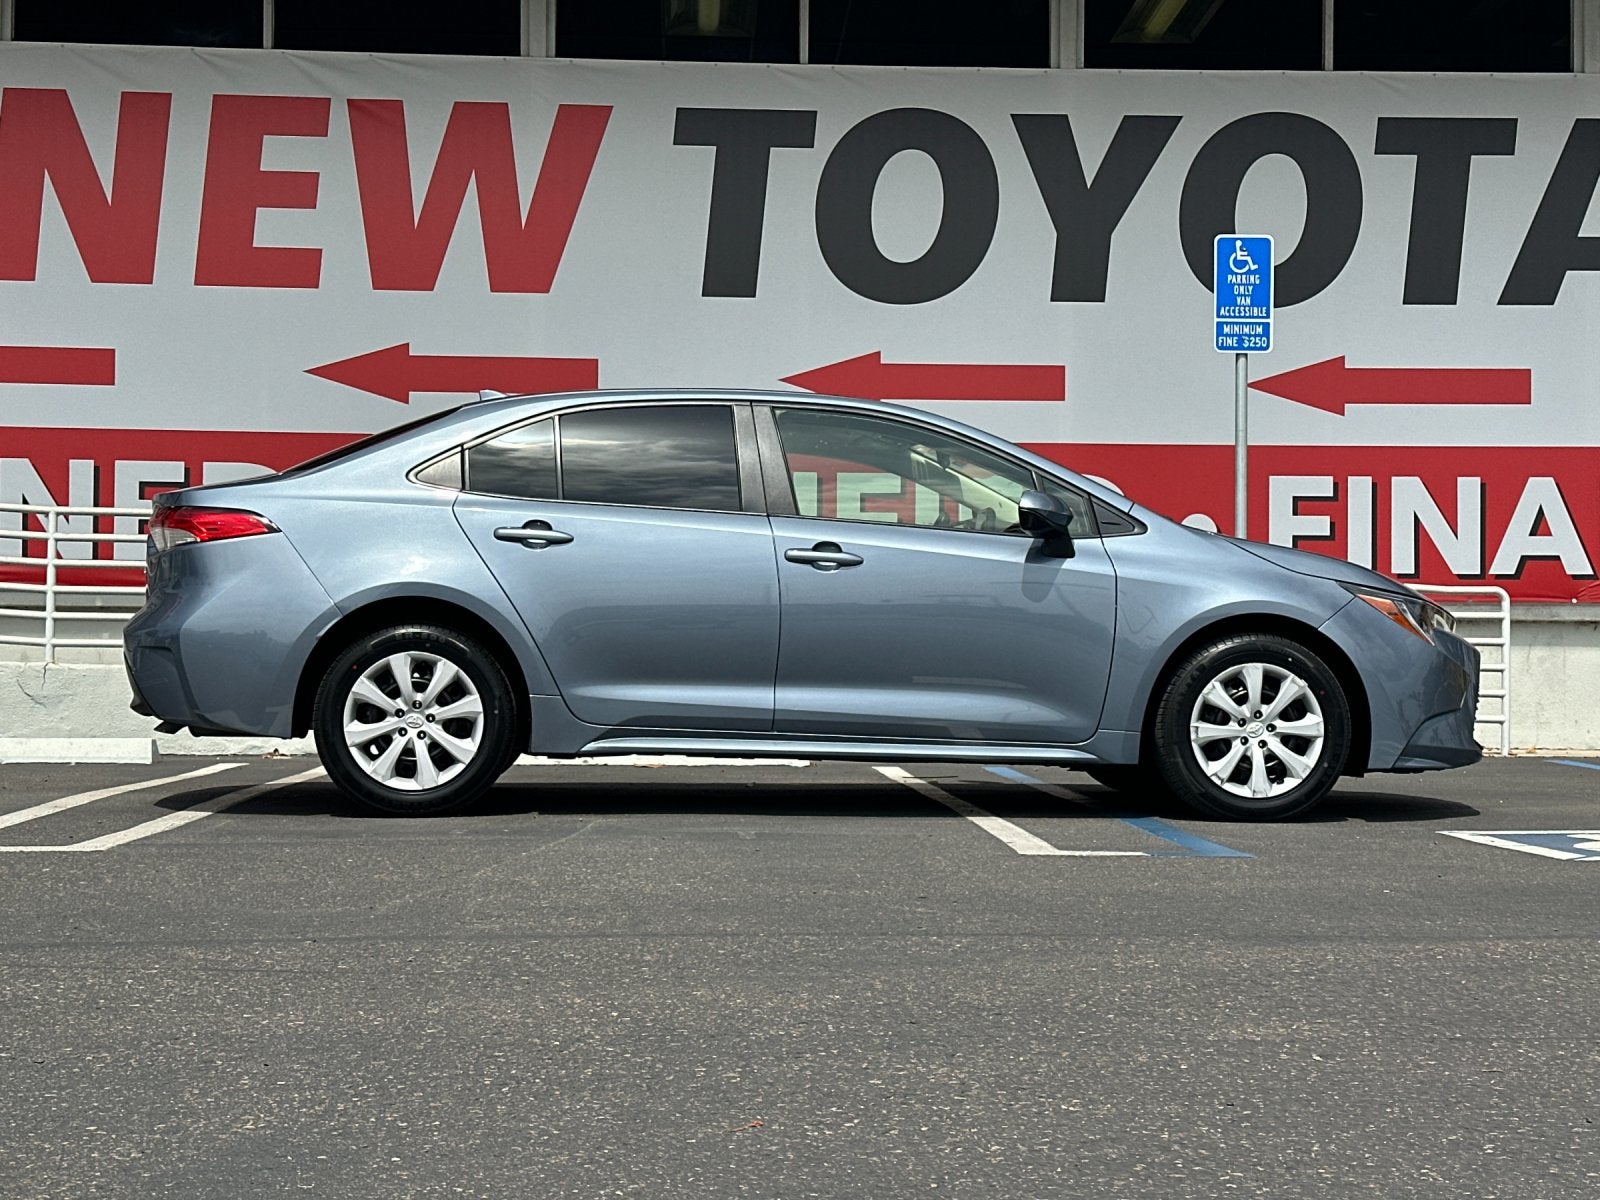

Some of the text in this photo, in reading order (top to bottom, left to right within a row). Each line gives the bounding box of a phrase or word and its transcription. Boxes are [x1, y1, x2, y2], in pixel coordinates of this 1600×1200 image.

[0, 87, 1600, 309] NEW TOYOTA
[1227, 274, 1260, 285] PARKING
[1233, 285, 1254, 295] ONLY
[1236, 296, 1251, 306] VAN
[1220, 306, 1267, 317] ACCESSIBLE
[1223, 324, 1263, 335] MINIMUM
[1218, 335, 1268, 348] FINE $250
[1268, 475, 1597, 579] FINA
